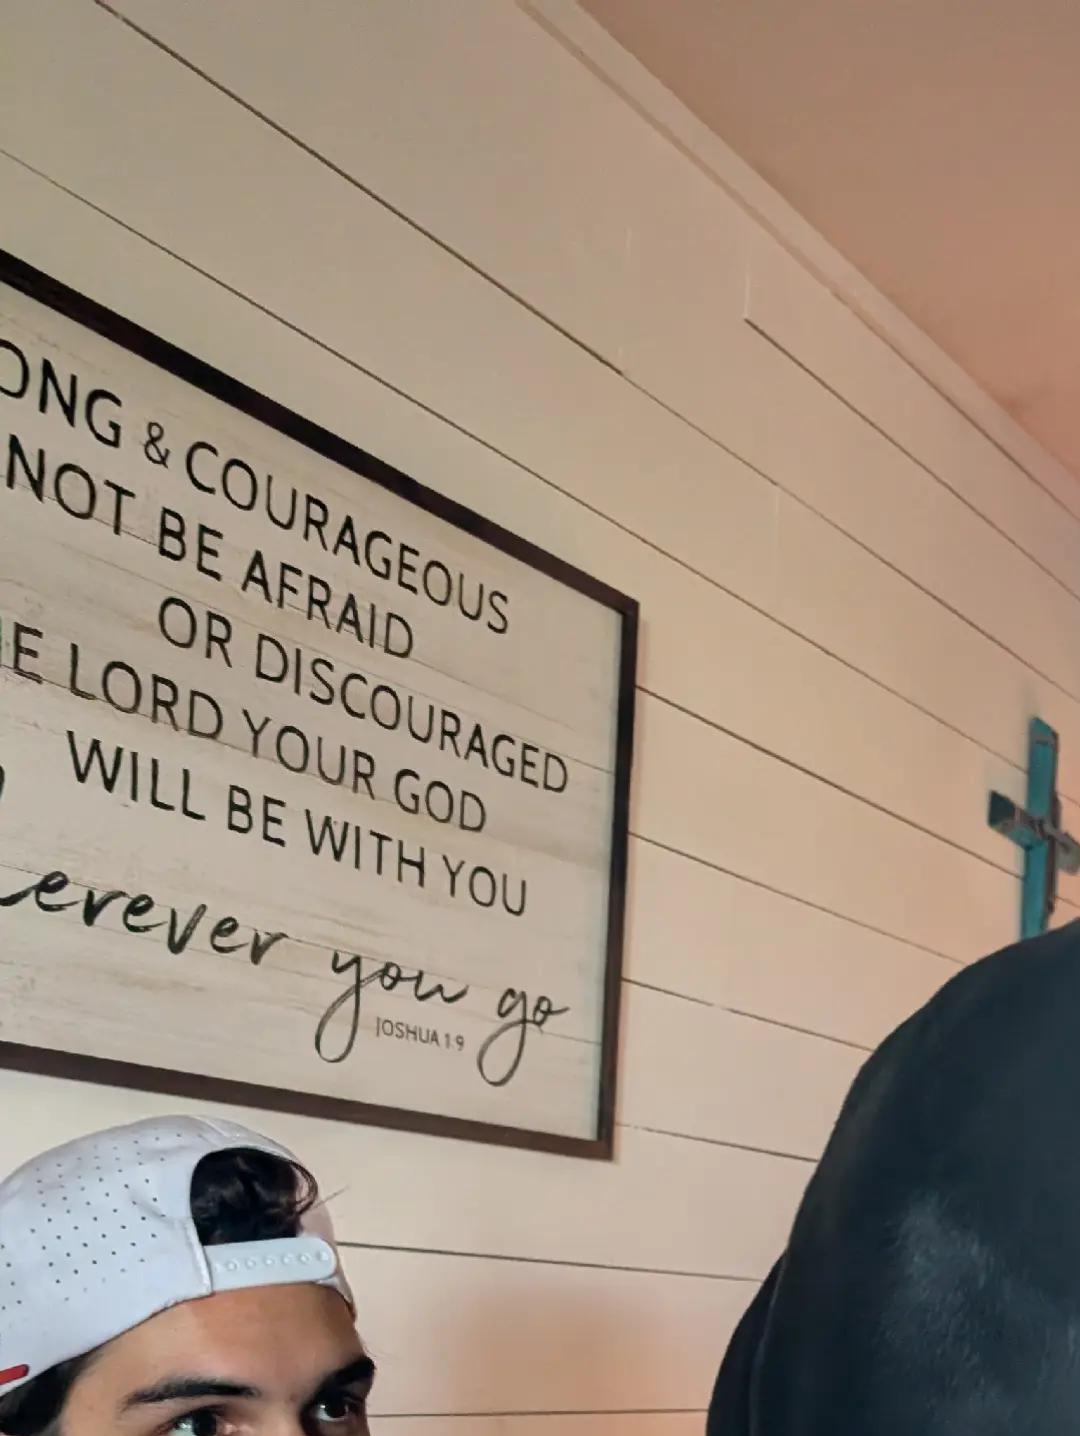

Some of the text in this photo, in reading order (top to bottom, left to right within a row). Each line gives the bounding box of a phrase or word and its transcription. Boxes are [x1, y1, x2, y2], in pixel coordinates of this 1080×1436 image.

[6, 434, 415, 660] NOT BE AFRAID
[143, 422, 170, 469] &
[186, 442, 511, 635] COURAGEOUS
[69, 643, 224, 740] LORD
[242, 708, 376, 800] YOUR
[394, 768, 487, 833] GOD
[159, 597, 568, 794] OR DISCOURAGED
[66, 730, 206, 821] WILL
[227, 784, 287, 847] BE
[305, 808, 426, 888] WITH
[442, 853, 527, 917] YOU
[315, 949, 470, 1064] you
[477, 985, 570, 1087] go
[376, 1016, 465, 1052] JOSHUA 19
